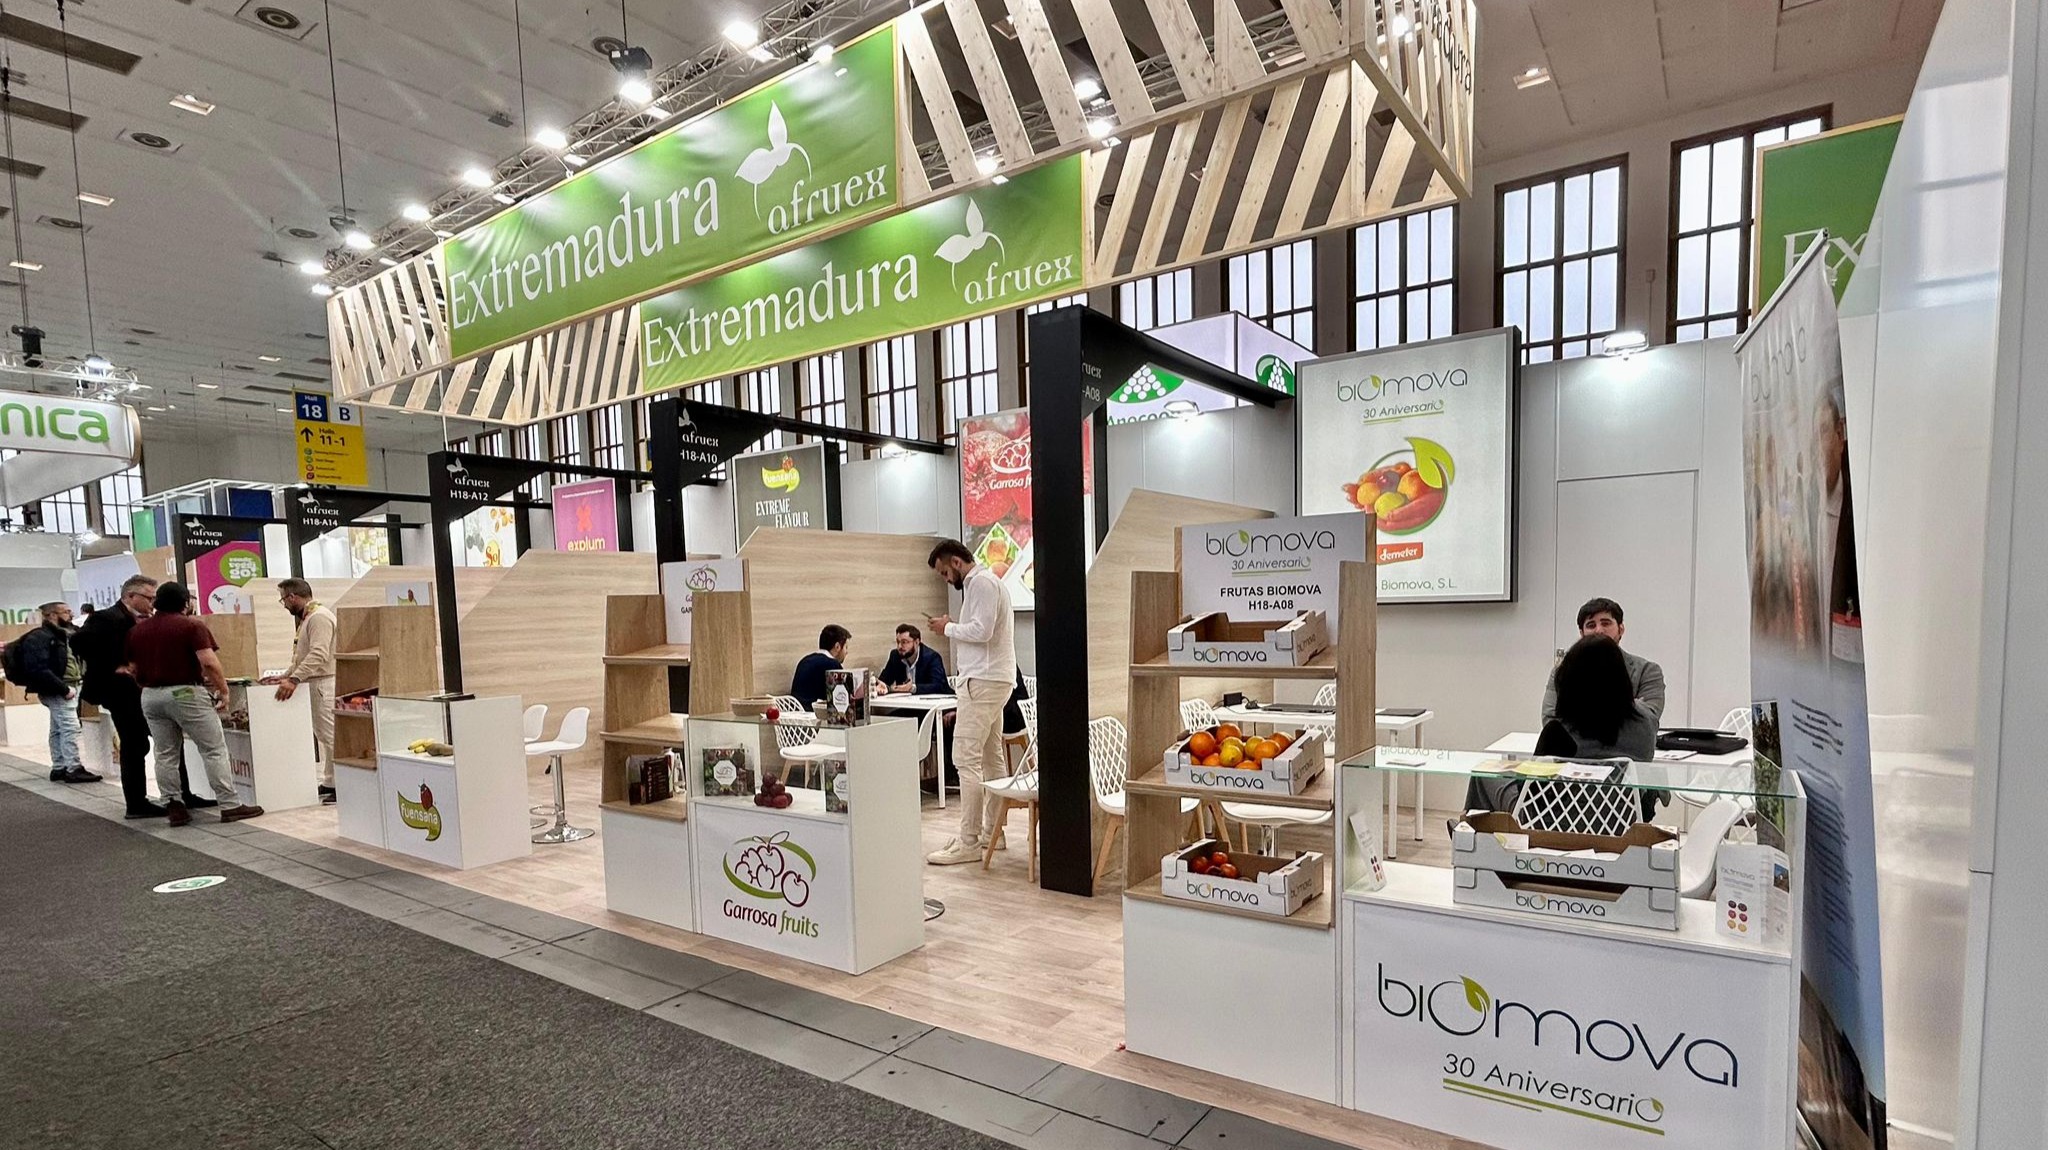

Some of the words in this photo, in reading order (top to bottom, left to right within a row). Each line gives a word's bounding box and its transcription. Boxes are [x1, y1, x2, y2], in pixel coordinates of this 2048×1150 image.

[768, 164, 888, 235] afruex
[449, 176, 719, 330] Extremadura
[964, 254, 1073, 305] afruex
[643, 253, 918, 368] Extremadura
[301, 403, 323, 419] 18
[339, 406, 351, 421] B
[1363, 407, 1377, 419] 30
[1380, 399, 1444, 417] Aniversario
[320, 434, 345, 447] 11-1
[682, 430, 719, 447] afruex
[454, 475, 490, 489] afruex
[989, 477, 1024, 490] Garrosa
[449, 489, 489, 502] H18-A12
[306, 505, 339, 516] afruex
[755, 498, 791, 516] EXTREME
[302, 517, 339, 527] H18-A14
[775, 511, 810, 528] FLAVOUR
[192, 529, 223, 537] afruex
[187, 538, 220, 546] H18-A16
[1379, 543, 1418, 560] demeter
[1231, 559, 1245, 571] 30
[1247, 556, 1312, 570] Aniversario
[1220, 585, 1264, 597] FRUTAS
[1267, 584, 1322, 596] BIOMOVA
[1248, 599, 1294, 611] H18-A08
[400, 802, 438, 825] fuensana
[723, 898, 777, 928] Garrosa
[778, 910, 820, 938] fruits
[1443, 1053, 1475, 1079] 30
[1484, 1063, 1665, 1124] Aniversario
